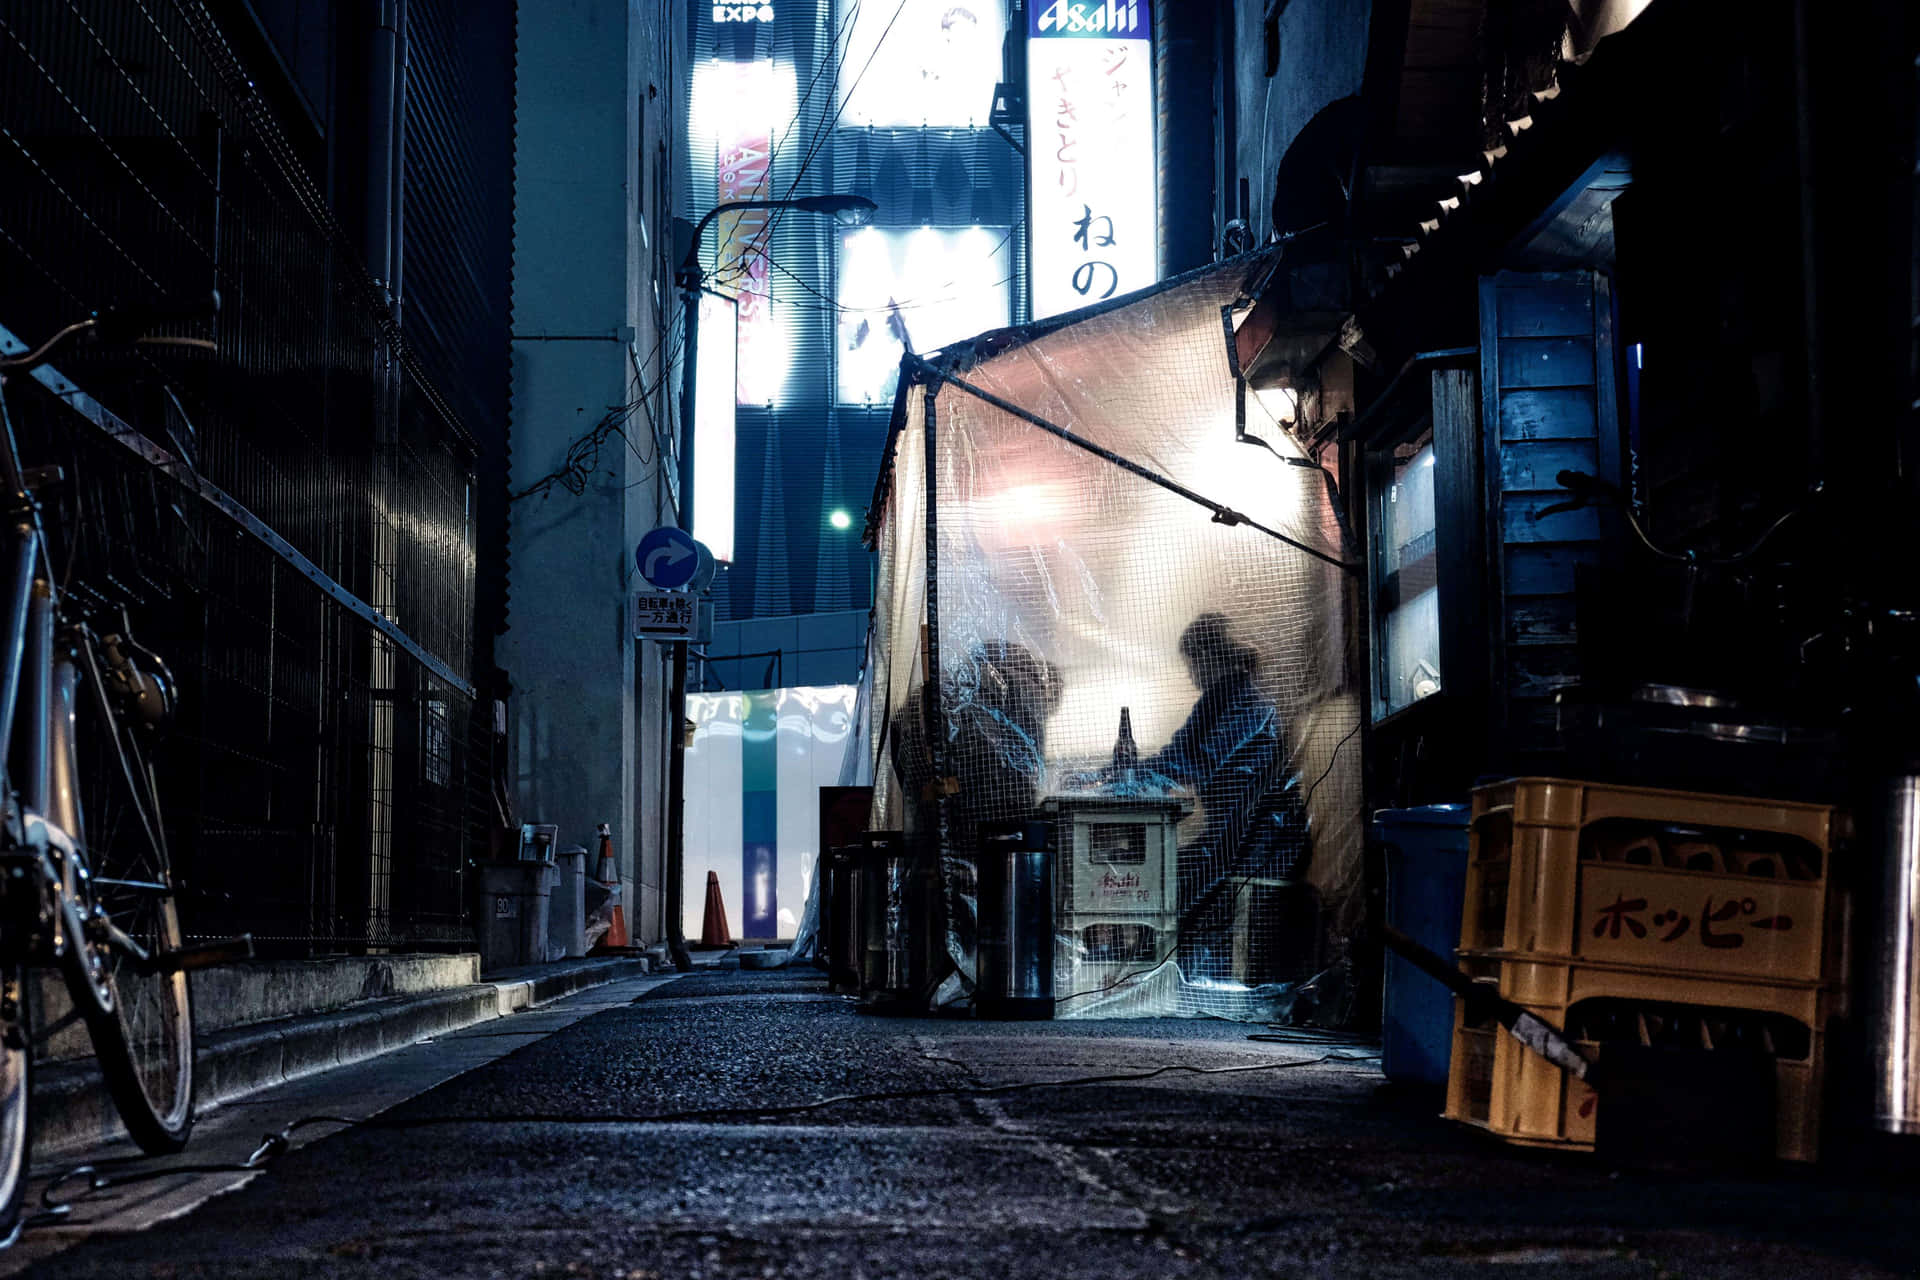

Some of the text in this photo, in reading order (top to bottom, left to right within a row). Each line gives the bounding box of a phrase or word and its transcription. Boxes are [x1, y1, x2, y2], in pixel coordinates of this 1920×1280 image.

[1038, 0, 1137, 32] Asahi
[1051, 66, 1078, 197] やきとり
[1594, 894, 1793, 948] ホッピー
